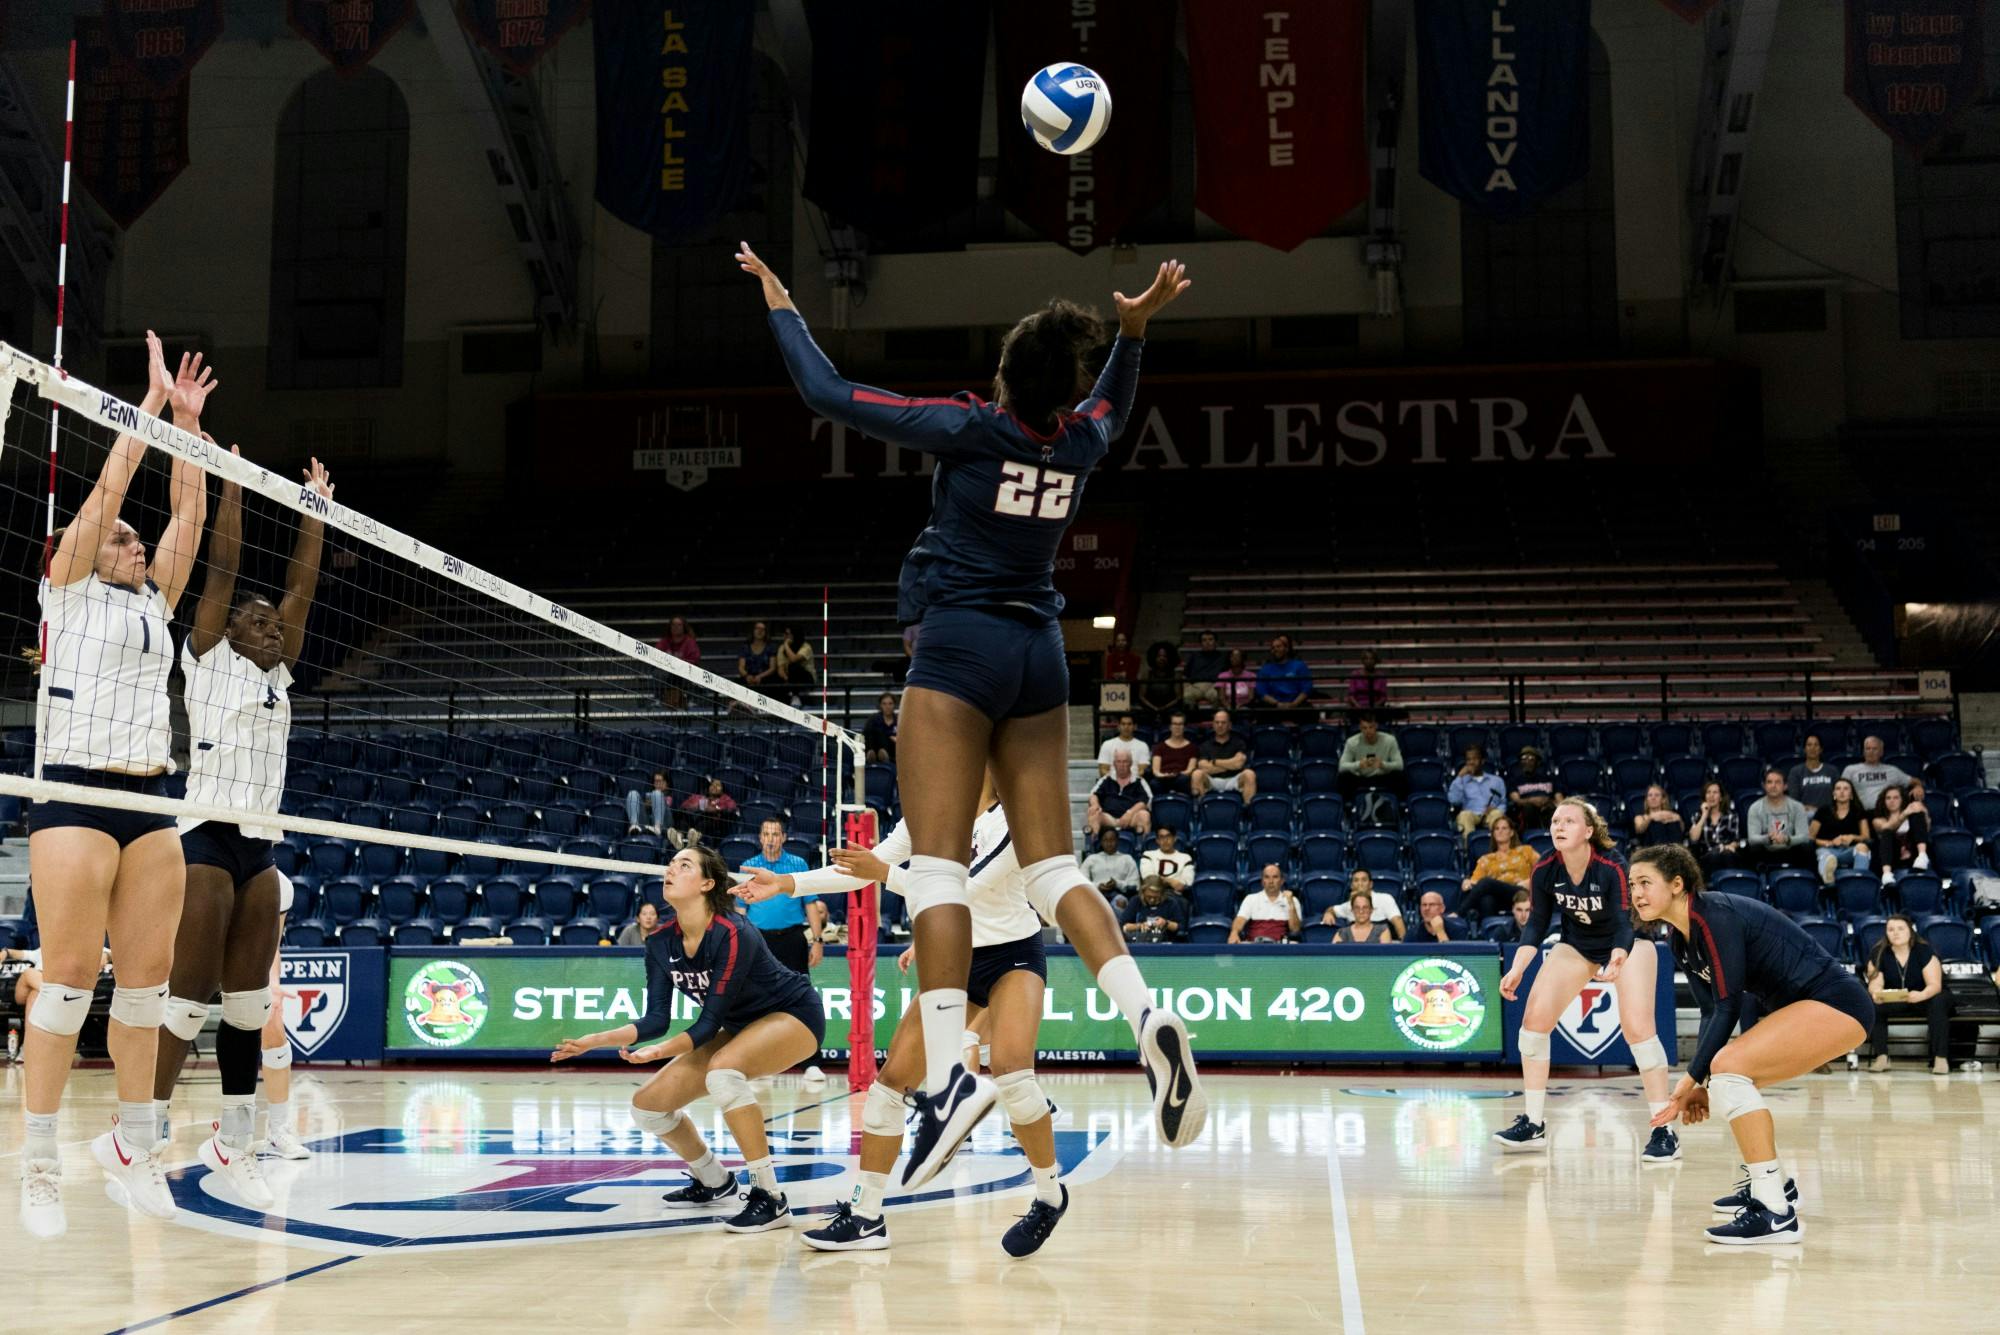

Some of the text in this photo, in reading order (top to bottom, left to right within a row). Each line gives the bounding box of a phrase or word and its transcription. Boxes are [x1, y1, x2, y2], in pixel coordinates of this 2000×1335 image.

[1260, 12, 1297, 167] TEMPLE
[660, 10, 690, 191] LA SALLE
[100, 393, 222, 469] PENN VOLLEYBALL
[1106, 393, 1615, 471] ALESTRA
[641, 451, 735, 466] THE PALESTRA
[994, 460, 1077, 519] 22
[299, 487, 388, 544] PENN VOLLEYBALL
[1896, 536, 1927, 552] 205
[443, 554, 465, 577] PENN
[1093, 556, 1120, 570] 204
[550, 603, 568, 623] PENN
[140, 615, 150, 653] 1
[1924, 679, 1948, 690] 104
[1104, 691, 1126, 702] 104
[1858, 772, 1888, 783] PENN
[1158, 858, 1179, 877] D
[1554, 892, 1603, 911] PENN
[1574, 911, 1592, 925] 3
[279, 960, 342, 978] PENN
[1942, 963, 1984, 975] PENN
[671, 969, 713, 990] PEN
[297, 990, 328, 1032] P
[1267, 986, 1366, 1022] 420
[1577, 988, 1612, 1034] P
[821, 1049, 838, 1059] TO
[1038, 1050, 1106, 1061] PALESTRA
